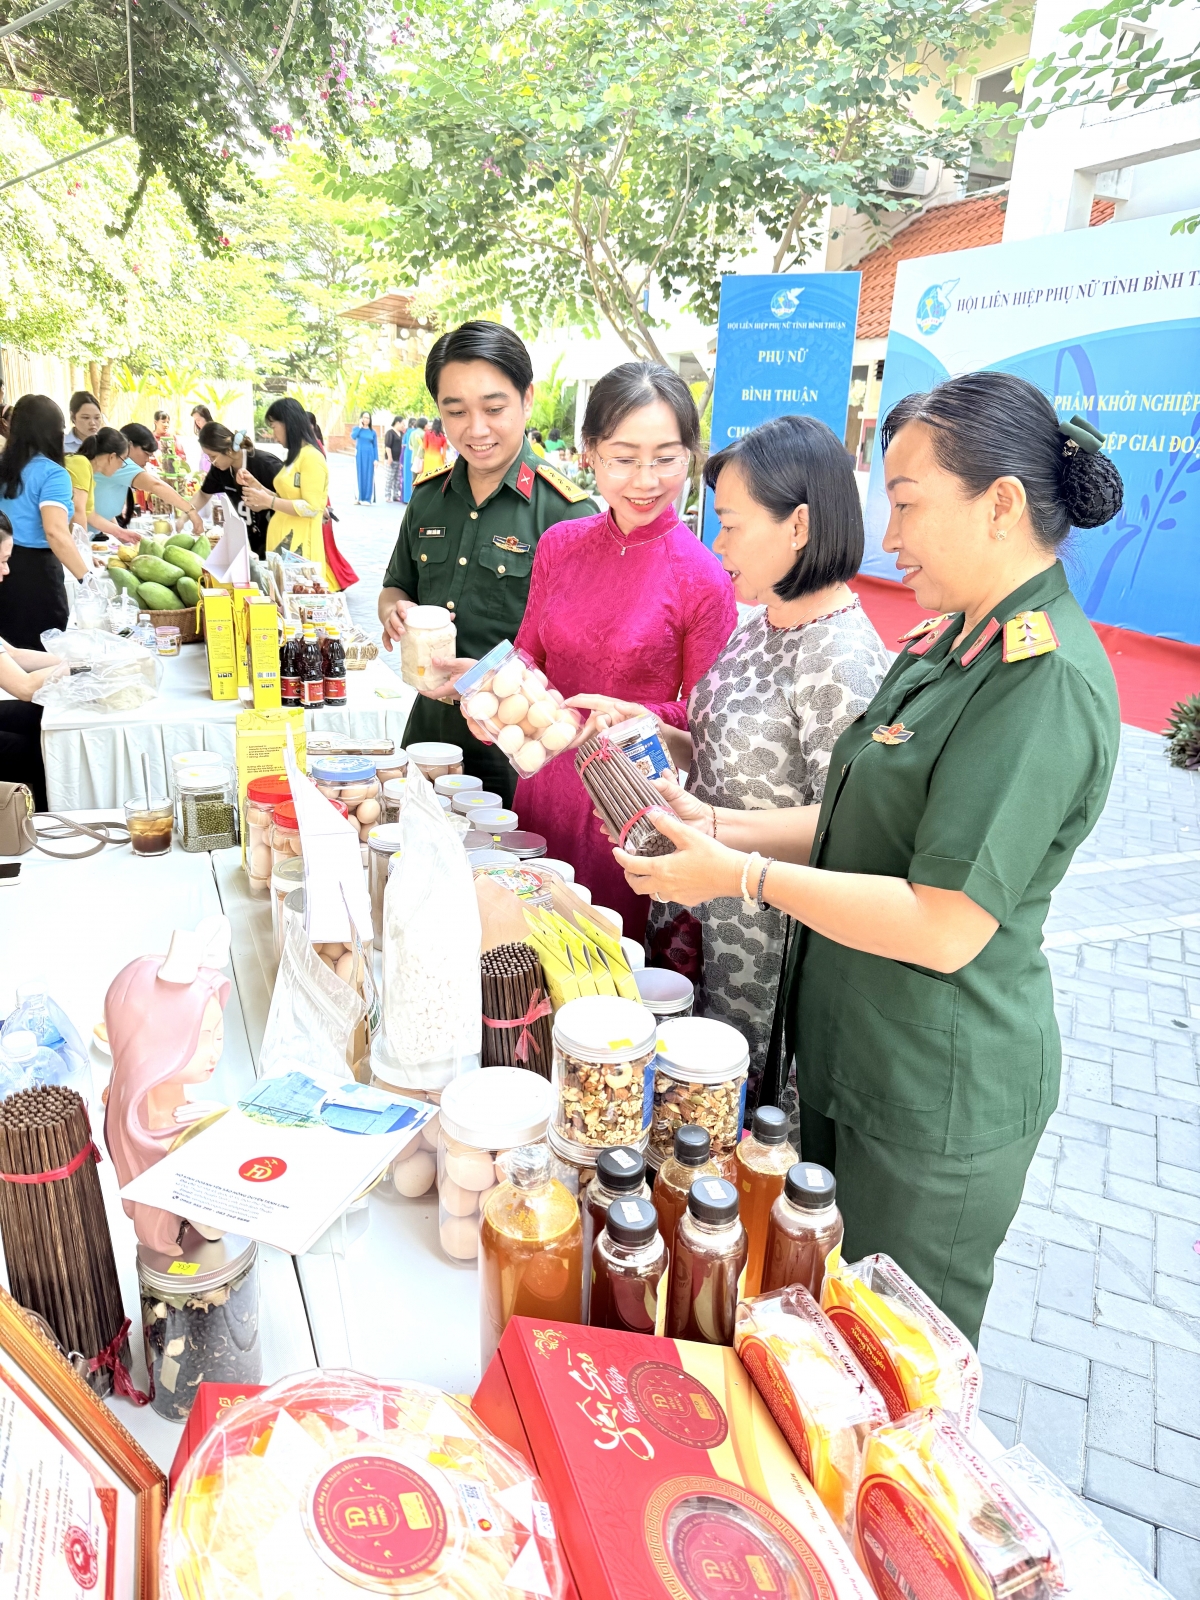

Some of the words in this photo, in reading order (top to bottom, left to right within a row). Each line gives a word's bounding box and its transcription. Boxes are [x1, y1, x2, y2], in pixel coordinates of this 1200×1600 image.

[957, 296, 979, 314] HỘI
[981, 290, 1010, 309] LIÊN
[1013, 288, 1044, 308] HIỆP
[1046, 286, 1074, 304] PHỤ
[1076, 280, 1101, 299] NỮ
[1102, 276, 1140, 296] TỈNH
[1142, 270, 1184, 292] BÌNH
[727, 322, 738, 331] HỘI
[740, 321, 753, 329] LIÊN
[754, 322, 768, 330] HIỆP
[769, 322, 780, 330] PHỤ
[808, 321, 823, 329] BÌNH
[824, 321, 846, 330] THUẬN
[758, 351, 784, 365] PHỤ
[787, 348, 809, 363] NỮ
[742, 386, 771, 401] BÌNH
[775, 386, 818, 406] THUẬN
[1097, 390, 1137, 411] KHỞI
[1139, 392, 1200, 416] NGHIỆP
[1129, 435, 1165, 452] GIAI
